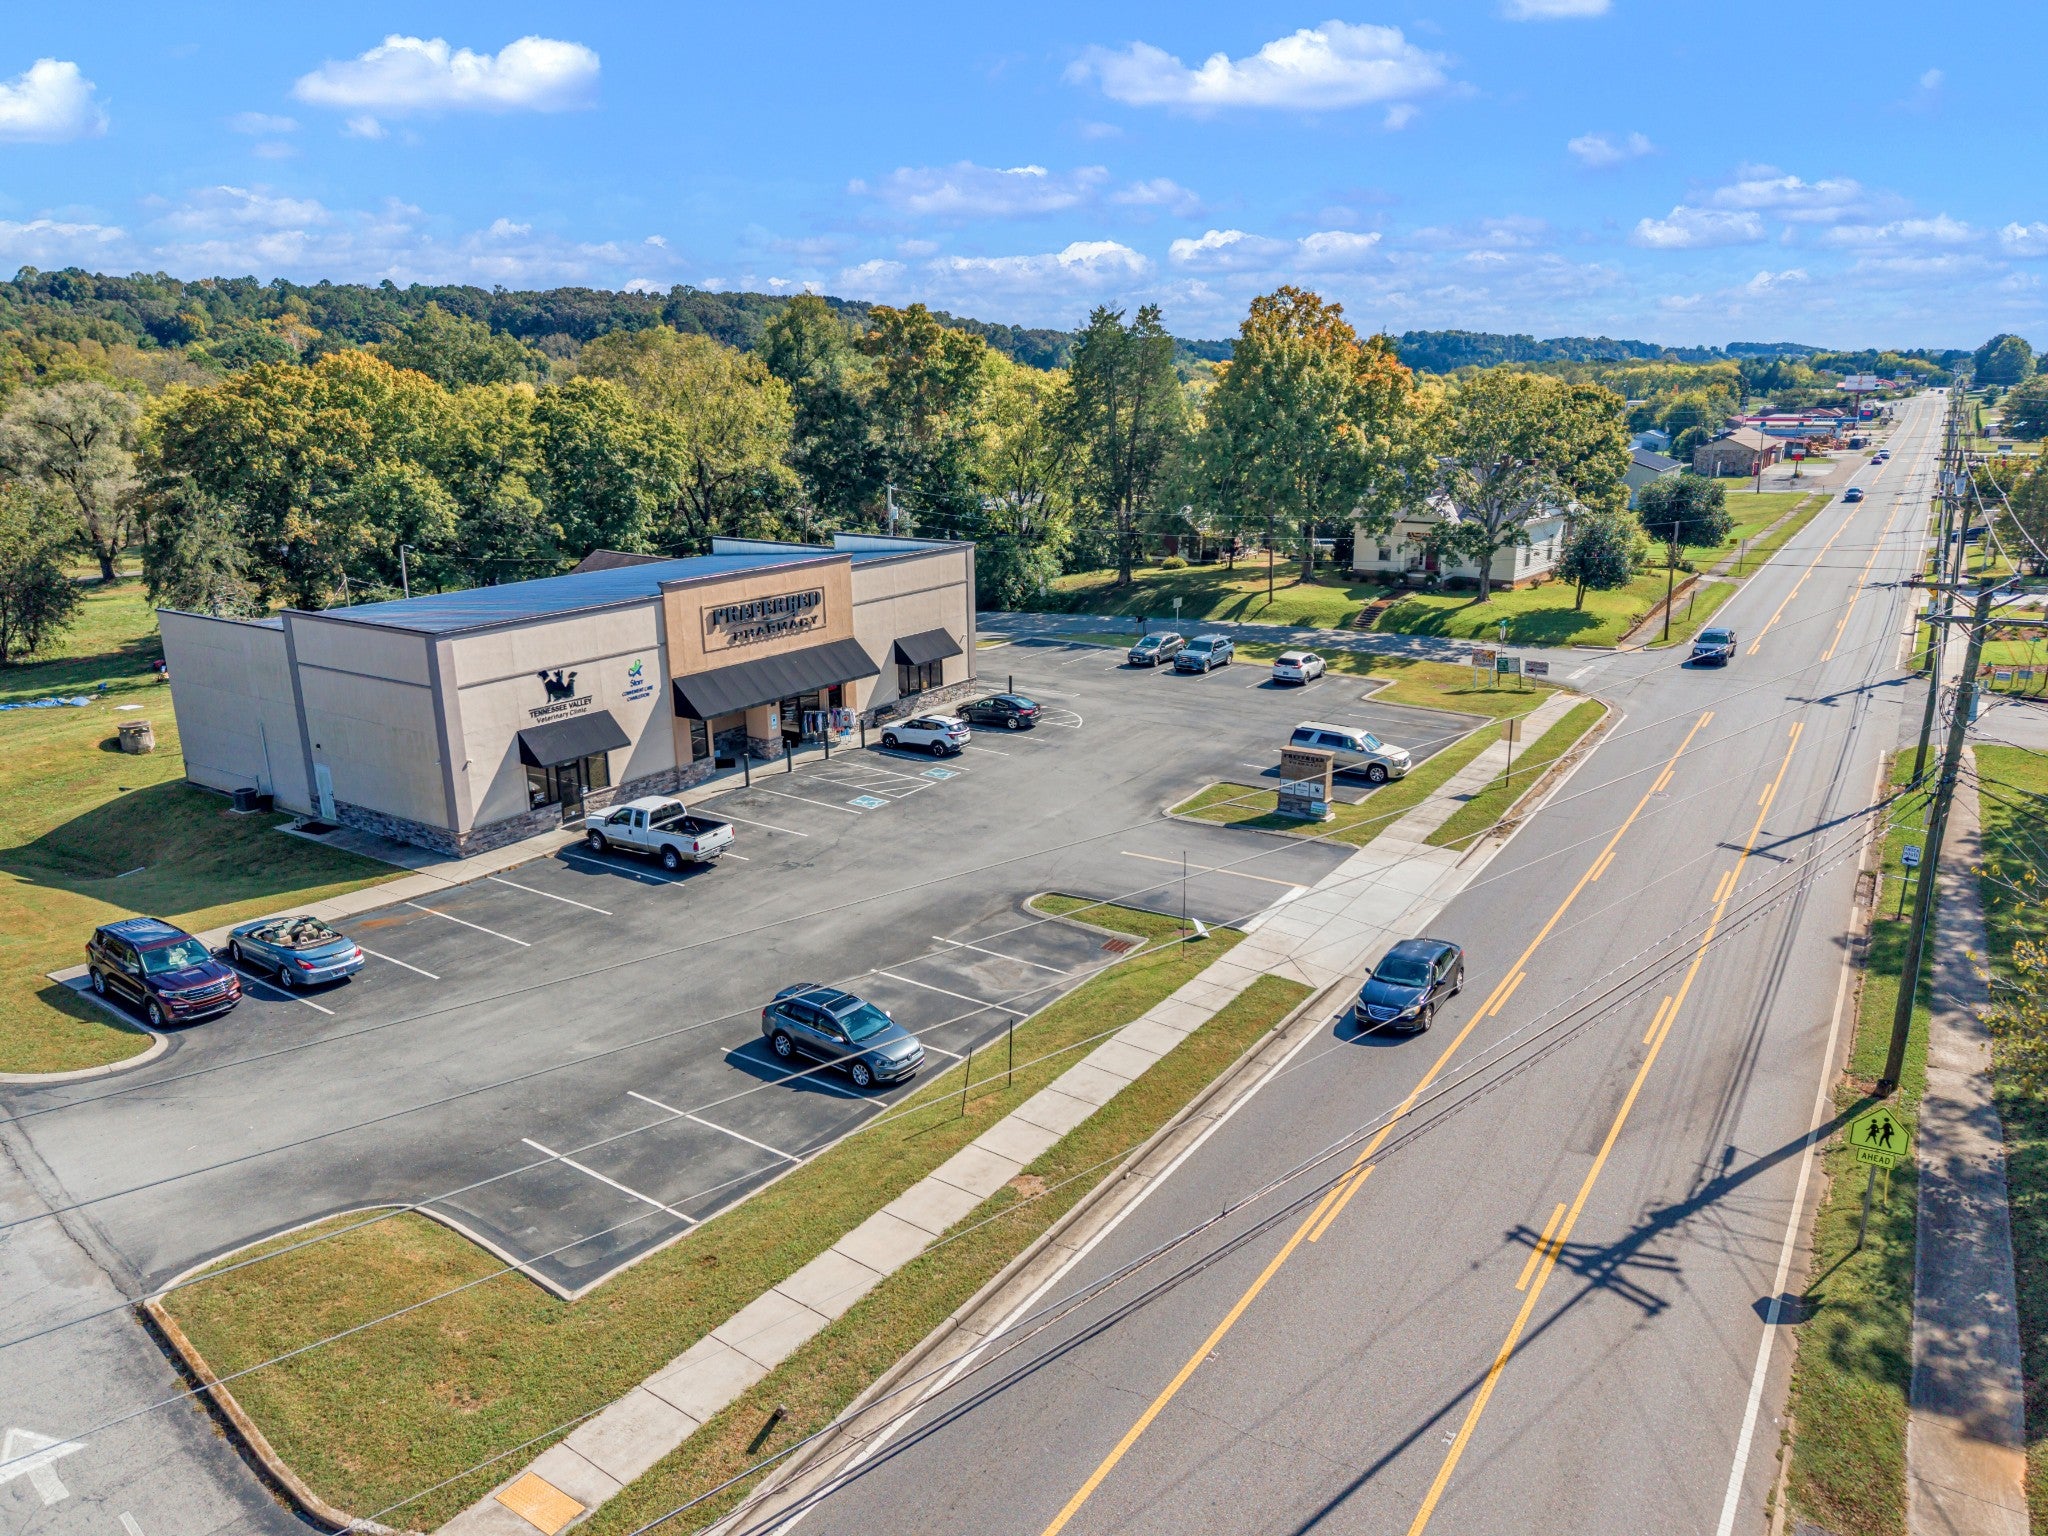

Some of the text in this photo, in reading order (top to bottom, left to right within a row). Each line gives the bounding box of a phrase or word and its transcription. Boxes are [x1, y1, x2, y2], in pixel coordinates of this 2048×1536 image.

[713, 591, 821, 626] PREFERRED
[733, 615, 818, 641] PHARMACY
[529, 698, 593, 718] TENNESSEE VALLEY
[536, 706, 588, 724] Veterinary Clinic
[1861, 1152, 1891, 1165] AHEAD
